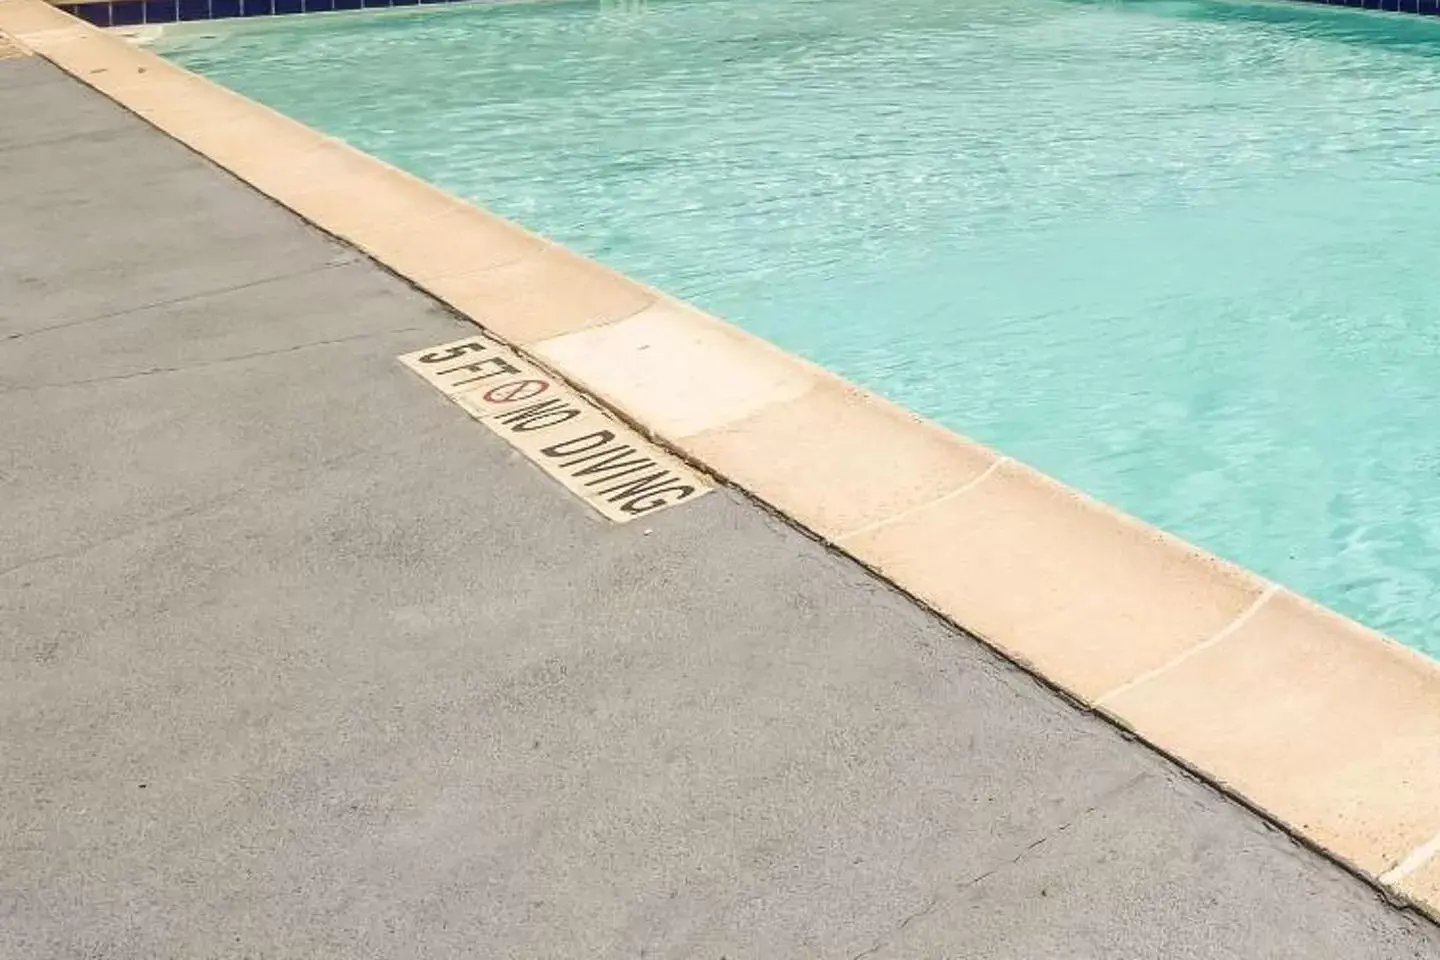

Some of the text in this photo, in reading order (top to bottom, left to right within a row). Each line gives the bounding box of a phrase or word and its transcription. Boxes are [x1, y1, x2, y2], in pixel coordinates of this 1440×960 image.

[419, 342, 695, 515] 5 FT NO DIVING
